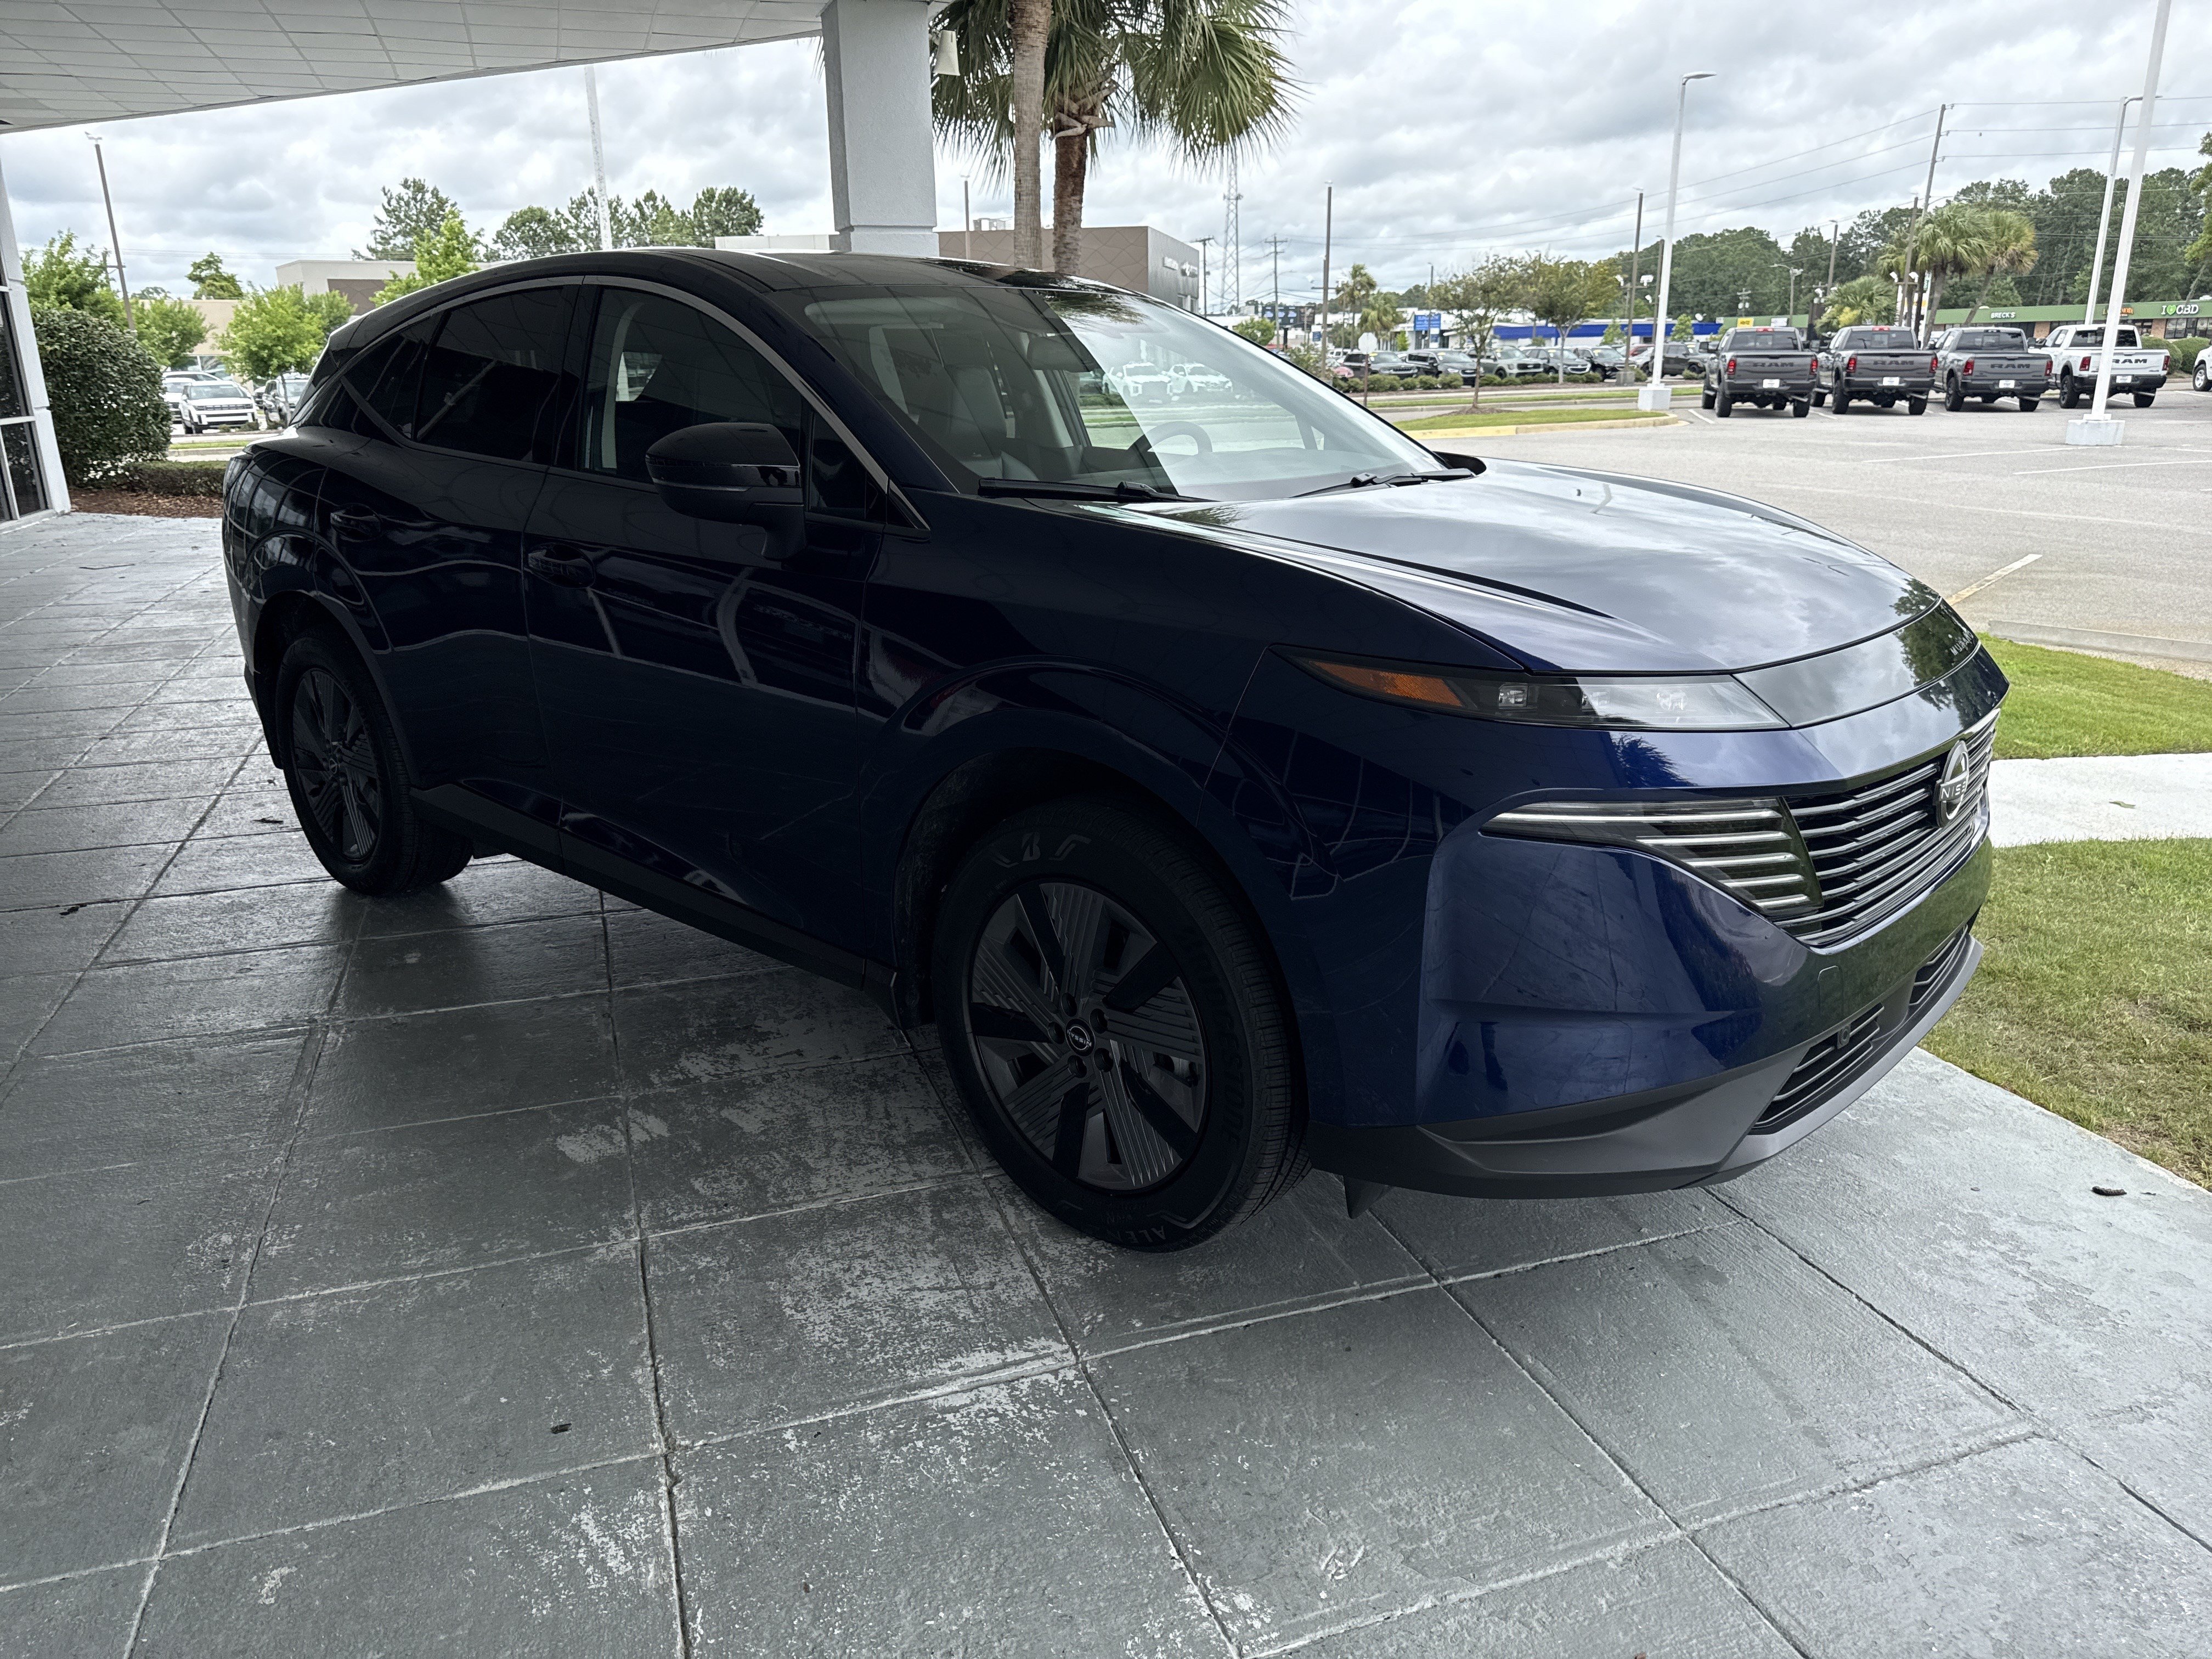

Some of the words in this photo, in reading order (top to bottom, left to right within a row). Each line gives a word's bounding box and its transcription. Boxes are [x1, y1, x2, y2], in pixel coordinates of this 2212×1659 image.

[2161, 305, 2166, 314] I
[2176, 304, 2199, 314] CBD
[1941, 781, 1966, 799] NISS
[1066, 1029, 1092, 1047] NISSAN
